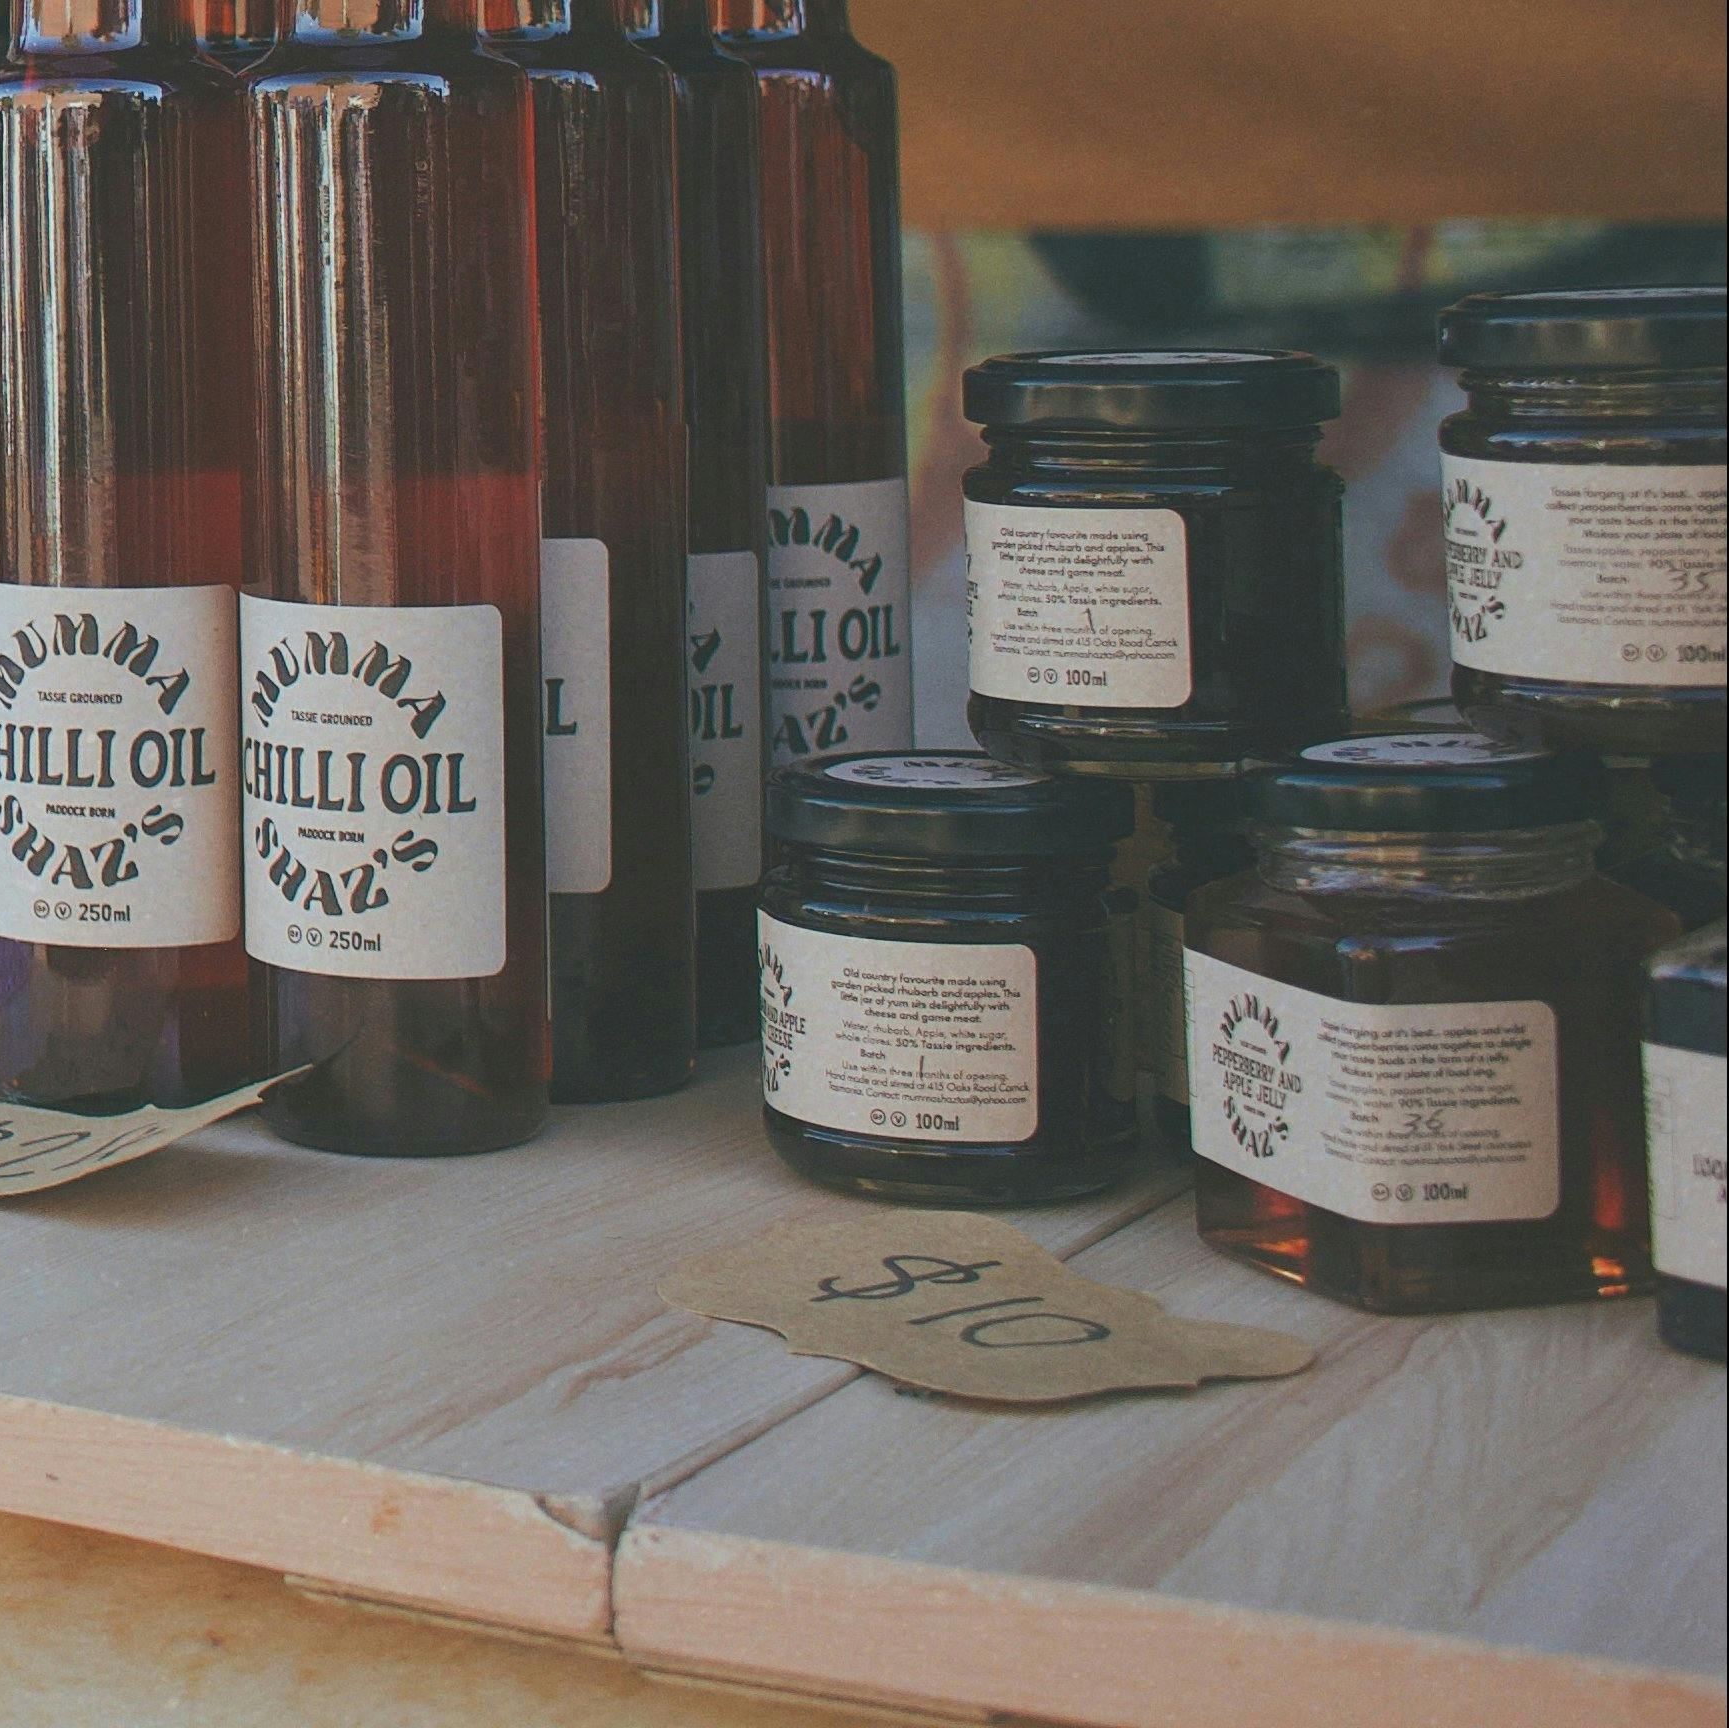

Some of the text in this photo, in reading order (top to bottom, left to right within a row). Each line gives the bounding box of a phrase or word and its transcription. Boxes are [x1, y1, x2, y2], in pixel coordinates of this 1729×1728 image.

[769, 506, 883, 595] MMA
[1492, 548, 1524, 569] AND
[1069, 596, 1097, 605] Tassie
[1100, 596, 1162, 607] ingredients.
[837, 603, 901, 661] OIL
[1450, 594, 1506, 643] HAZ'S
[251, 631, 446, 740] MUMMA
[1066, 669, 1107, 686] 100ml
[37, 690, 123, 705] TASSIE GROUNDED
[291, 710, 373, 726] TASSIE GROUNDED
[772, 674, 882, 755] AZ'S
[129, 727, 216, 789] OIL
[244, 737, 477, 814] CHILLI OIL
[46, 803, 117, 818] PADDOCK BORN
[298, 827, 365, 843] PADDOCK BORN
[255, 817, 439, 917] SHAZ'S
[78, 902, 131, 922] 250ml
[329, 930, 382, 952] 250ml
[1219, 992, 1290, 1065] MUMMA
[860, 1048, 885, 1060] Batch
[921, 1040, 952, 1050] Tassie
[956, 1042, 1016, 1053] ingredients.
[1212, 1041, 1276, 1084] PEPPERBERRY
[1277, 1071, 1303, 1094] AND
[1223, 1071, 1287, 1110] APPLE JELLY
[915, 1113, 959, 1131] 100ml
[1223, 1095, 1289, 1159] SHAZ'S
[1422, 1182, 1470, 1202] 100ml
[810, 1254, 1112, 1349] $10
